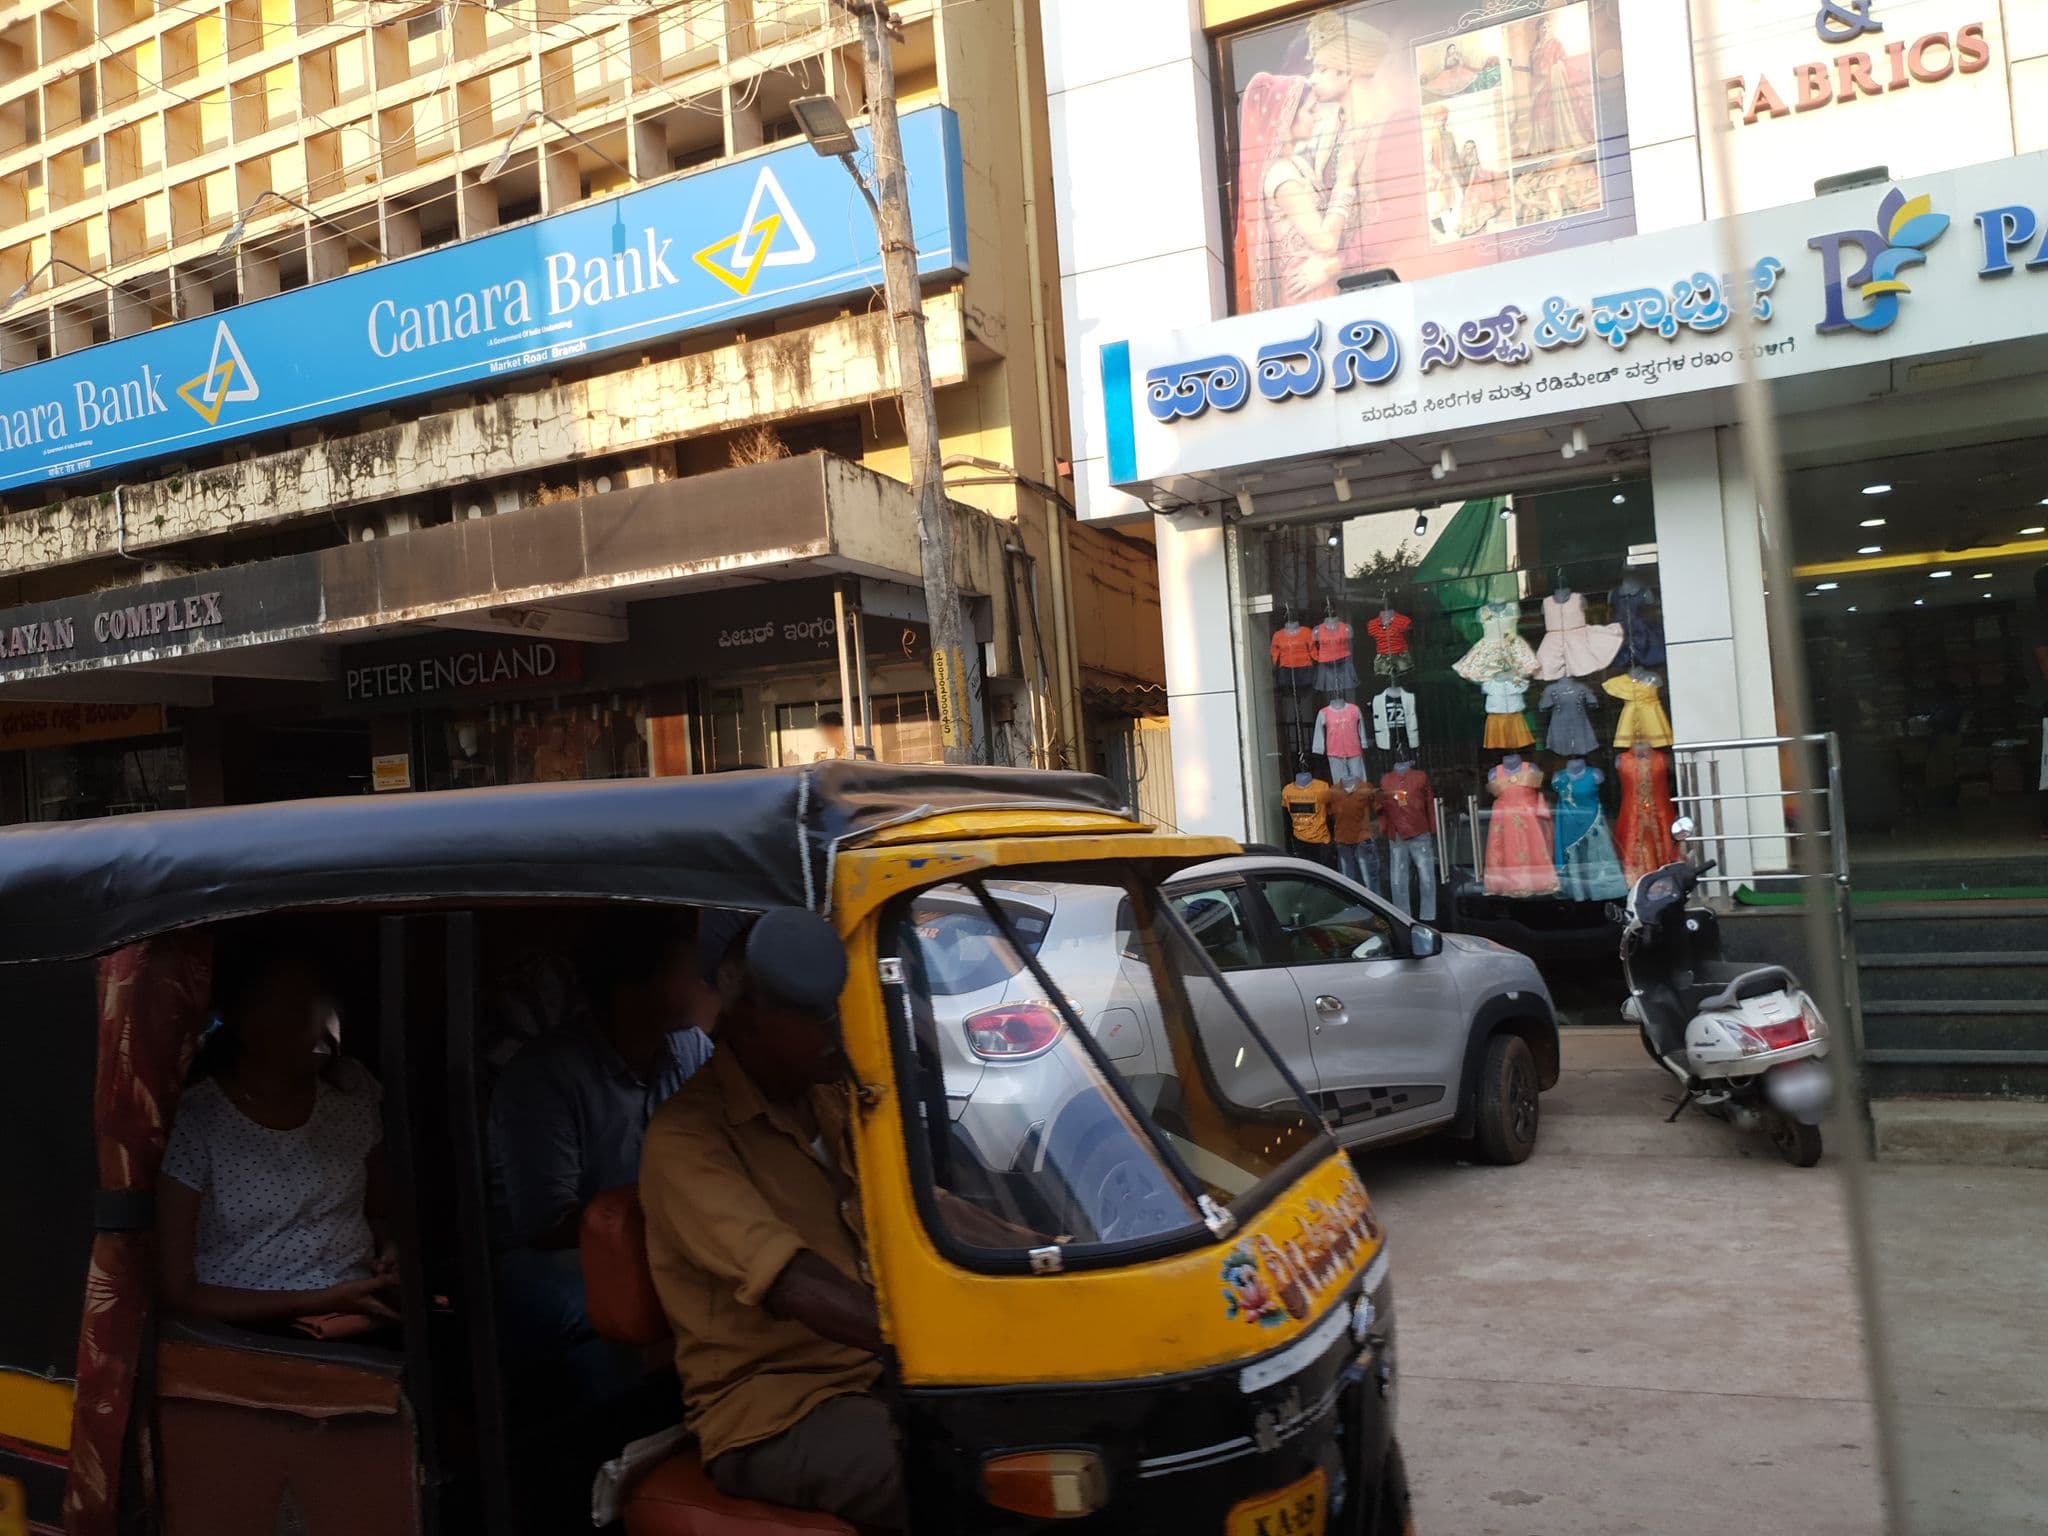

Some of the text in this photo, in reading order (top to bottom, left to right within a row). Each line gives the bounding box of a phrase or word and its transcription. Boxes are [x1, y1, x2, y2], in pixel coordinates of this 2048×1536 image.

[1714, 22, 1990, 131] FABRICS
[368, 227, 680, 358] Canara Bank
[489, 341, 586, 373] Market Road Branch
[1146, 318, 1401, 424] ಪಾವನಿ
[1533, 296, 1588, 351] &
[73, 364, 168, 432] Bank
[1362, 400, 1418, 422] ಮದುವೆ
[1489, 381, 1532, 402] ಮತ್ತು
[94, 592, 224, 643] COMPLEX
[346, 643, 556, 701] PETER ENGLAND
[1387, 708, 1405, 722] 72
